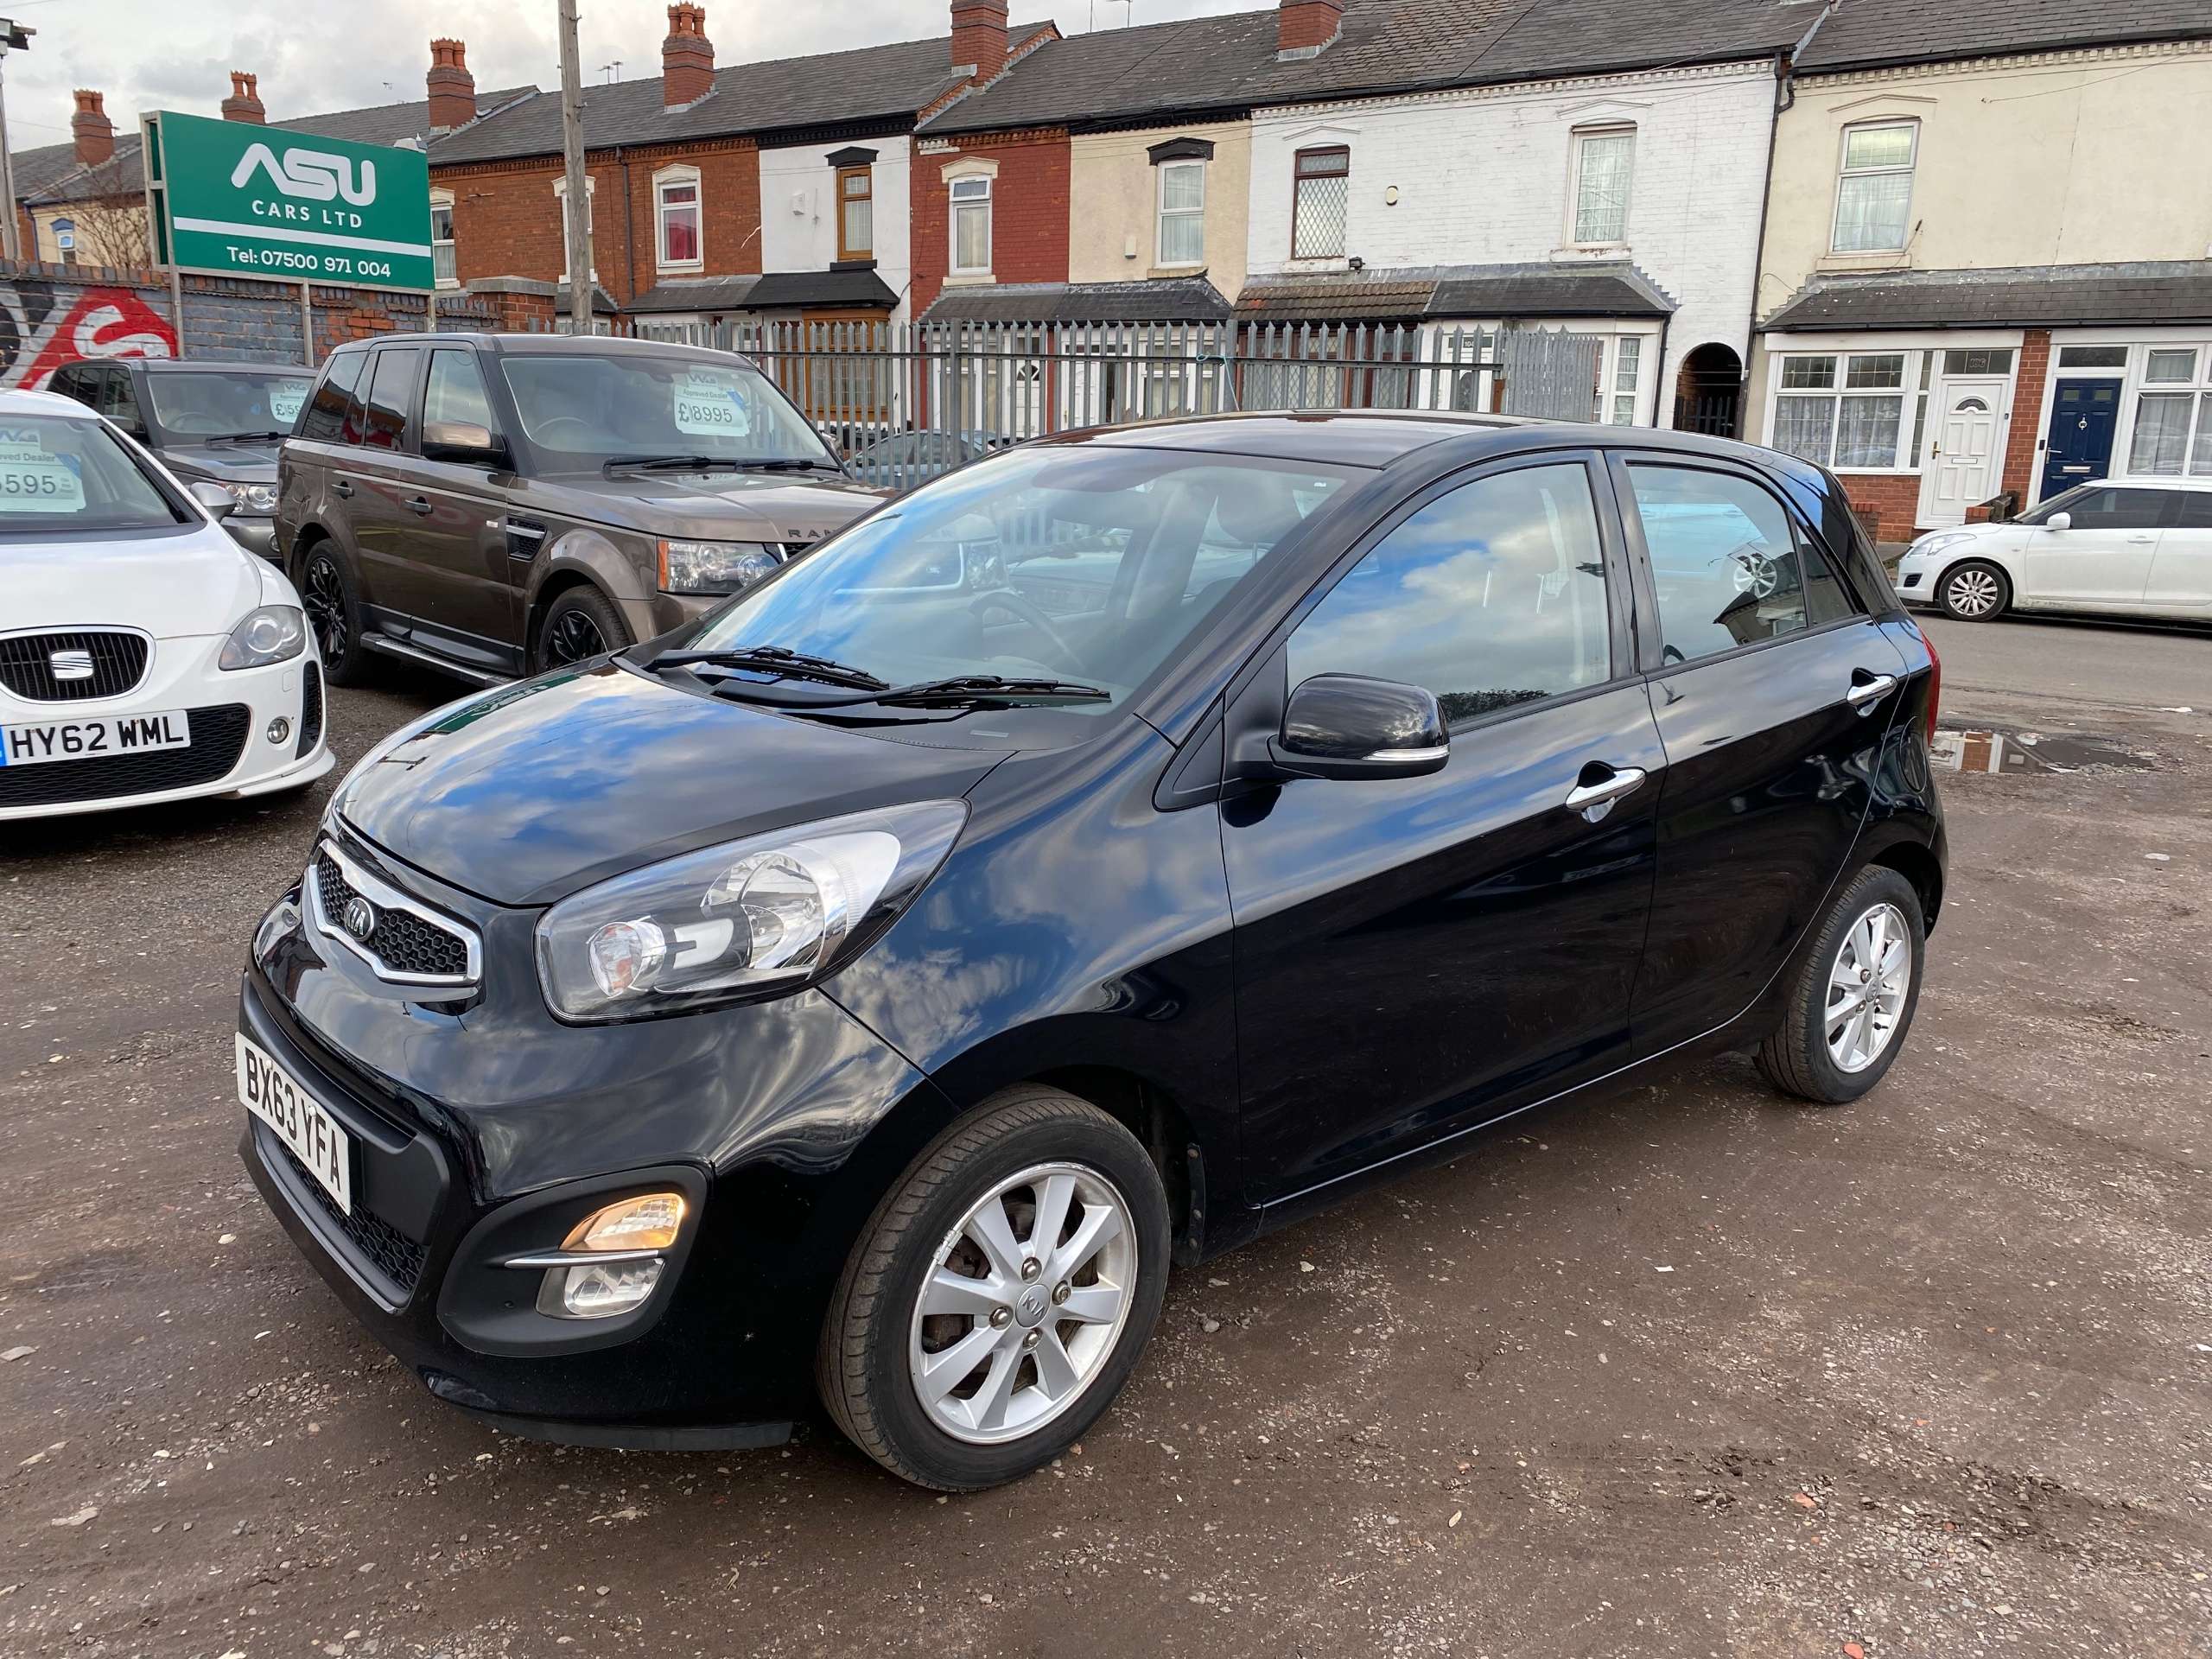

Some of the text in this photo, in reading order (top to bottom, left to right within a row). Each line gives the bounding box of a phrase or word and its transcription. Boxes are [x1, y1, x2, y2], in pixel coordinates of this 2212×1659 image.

[231, 143, 376, 207] ASU
[251, 200, 362, 228] CARS LTD
[226, 245, 391, 277] Tel: 07500 971 004
[678, 403, 733, 423] £8995
[0, 474, 56, 494] 595
[10, 715, 184, 758] HY62 WML
[347, 900, 366, 936] KIA
[245, 1046, 297, 1141] BX63
[301, 1096, 341, 1192] YFA
[1021, 1294, 1046, 1319] KIA
